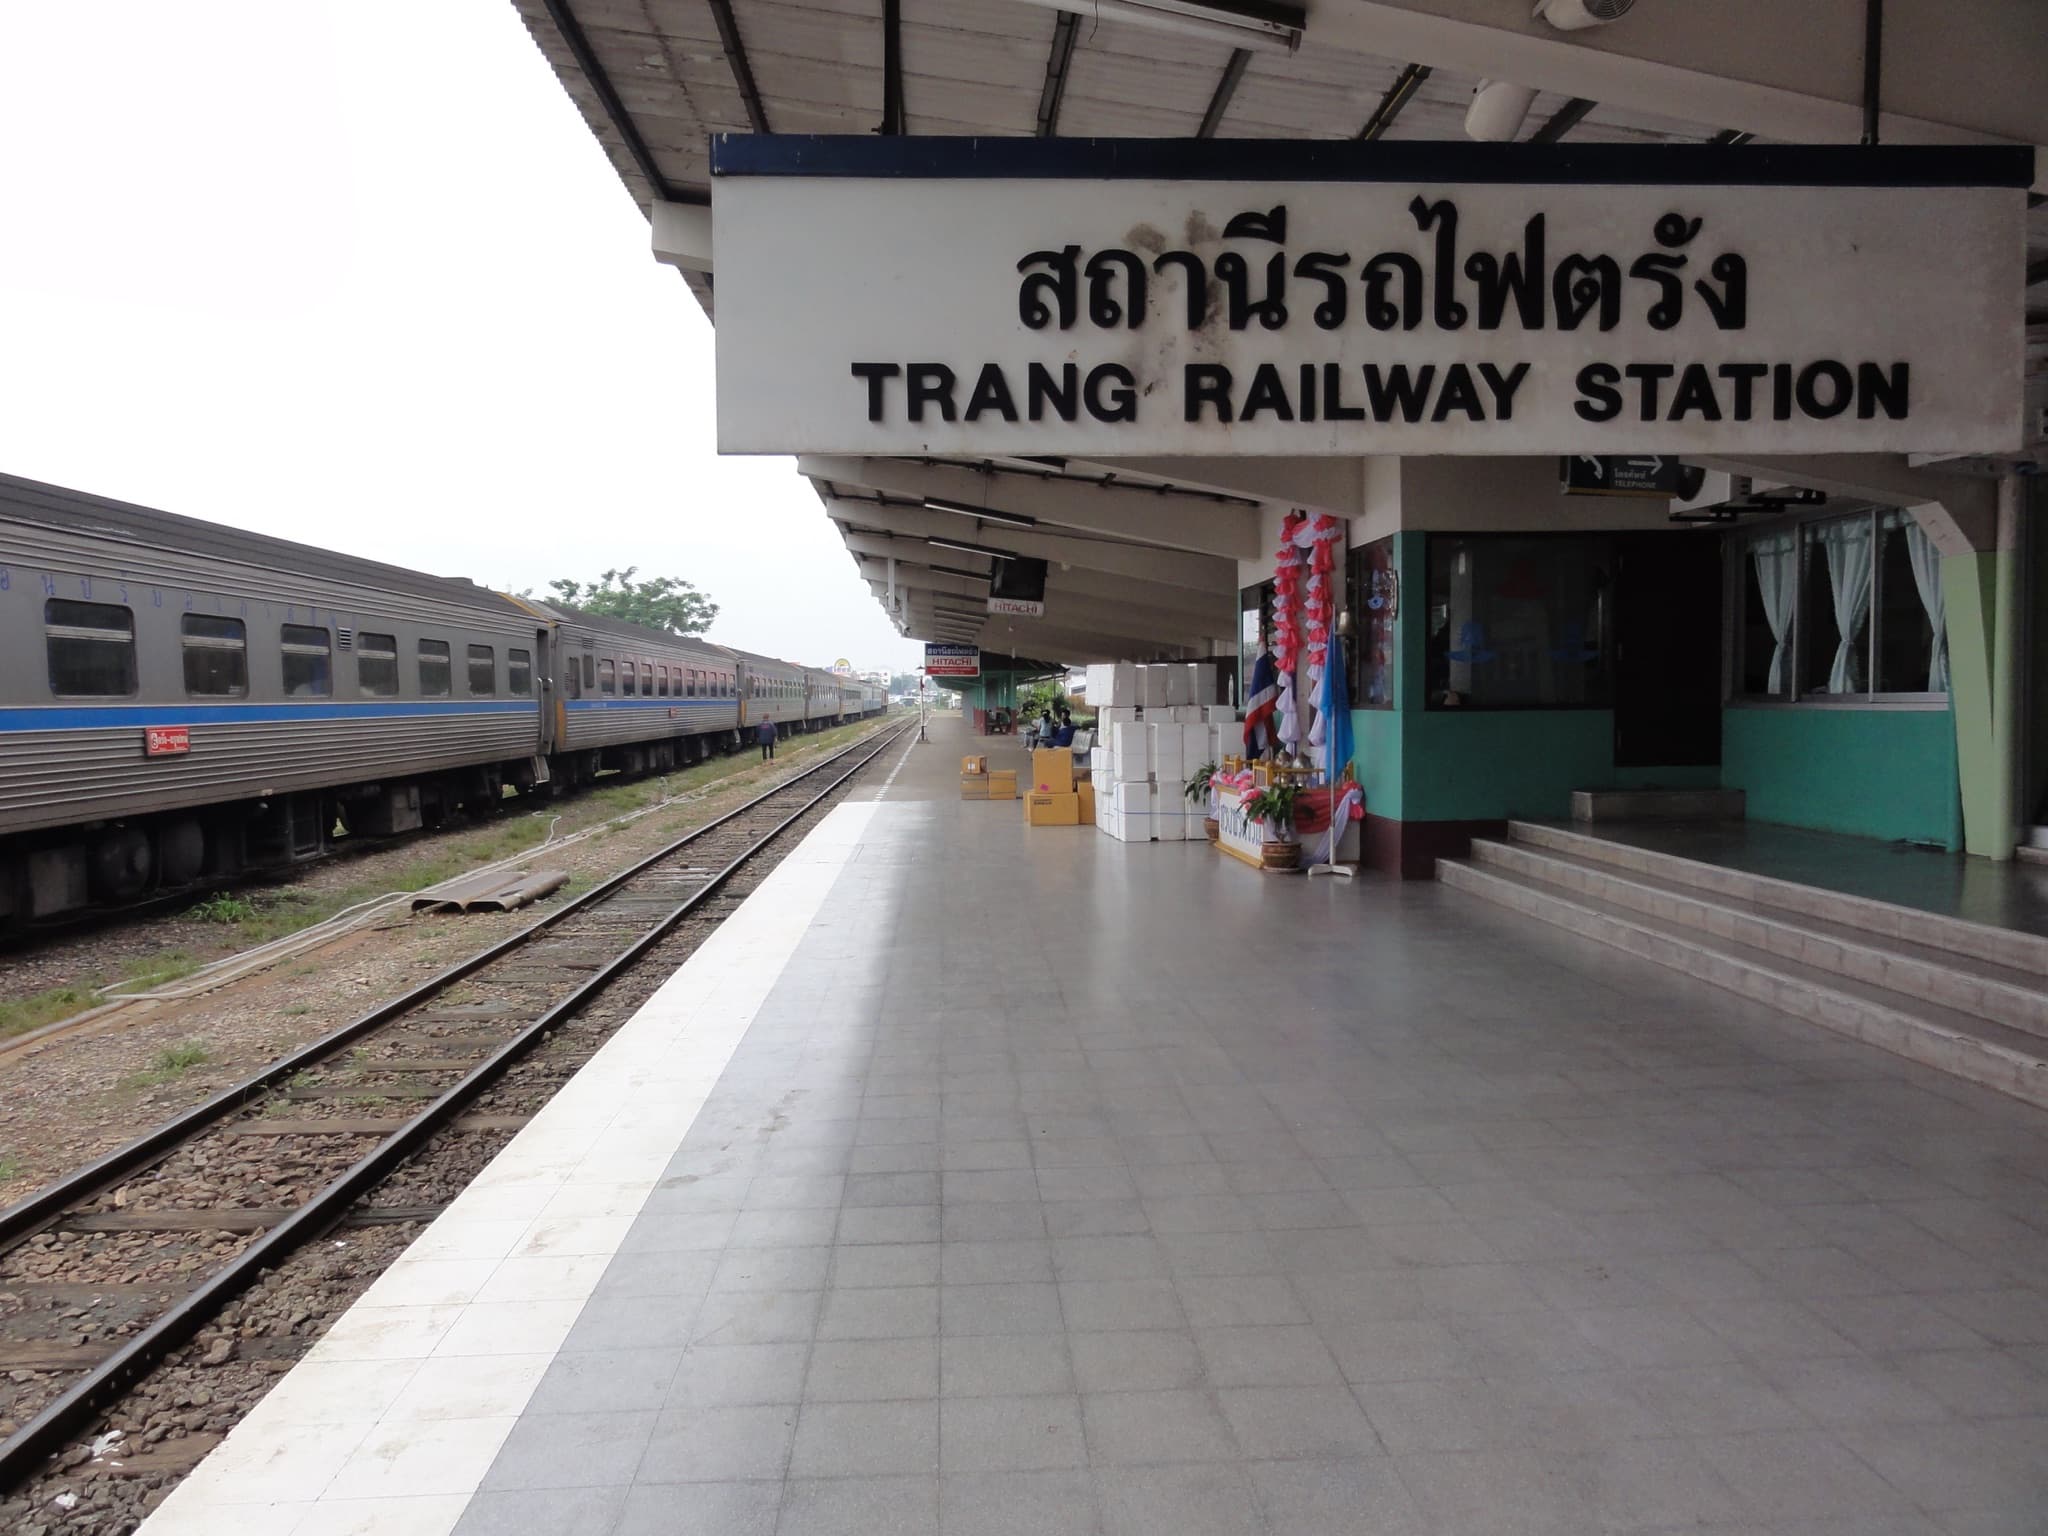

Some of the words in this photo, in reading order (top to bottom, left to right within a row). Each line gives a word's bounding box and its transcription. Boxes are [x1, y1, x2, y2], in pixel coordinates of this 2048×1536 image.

[1016, 194, 1747, 332] สถานีรถไฟตรัง
[851, 362, 1136, 422] TRANG
[1184, 362, 1531, 423] RAILWAY
[1573, 360, 1910, 422] STATION
[1615, 480, 1656, 489] TELEPHONE
[994, 602, 1038, 614] HITACHI
[932, 657, 972, 666] HITACHI
